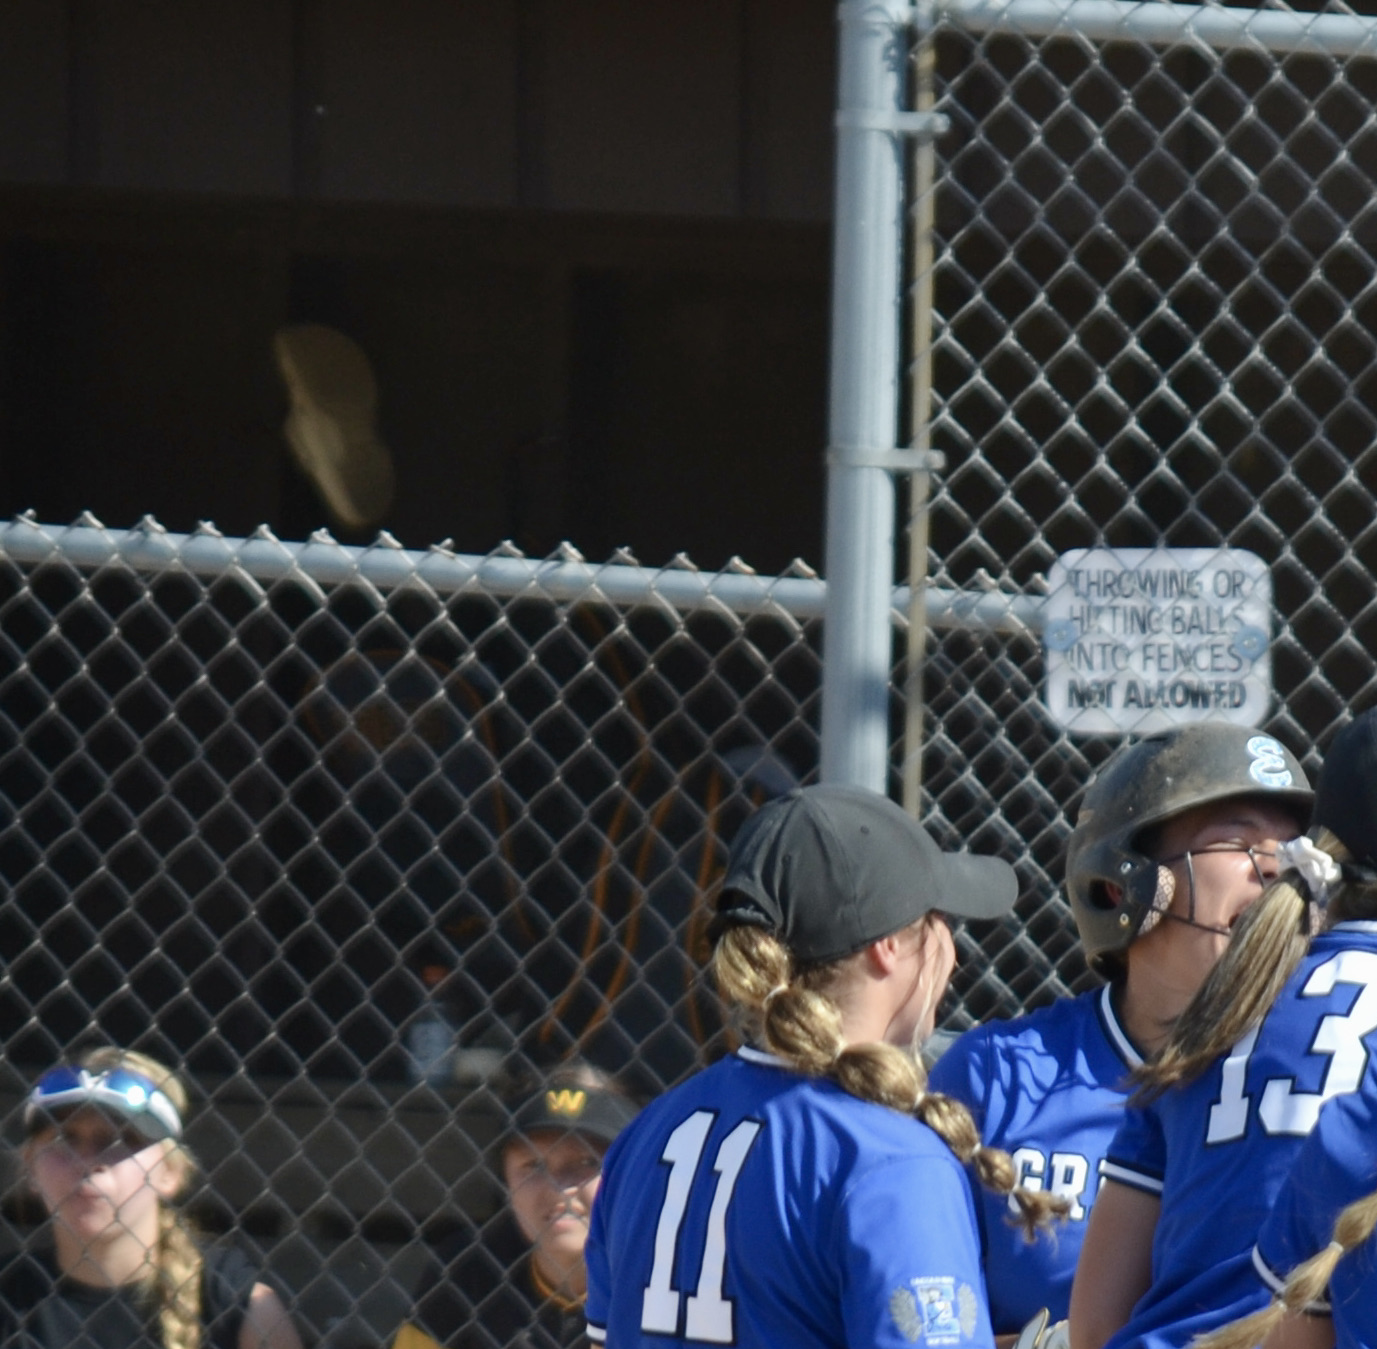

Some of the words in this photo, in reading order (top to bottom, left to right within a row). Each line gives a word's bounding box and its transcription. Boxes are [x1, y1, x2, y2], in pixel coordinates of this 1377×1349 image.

[1069, 569, 1203, 599] THROWING
[1213, 569, 1246, 598] OR
[1069, 604, 1163, 634] HITTING
[1171, 605, 1246, 635] BALLS
[1069, 642, 1129, 672] INTO
[1142, 643, 1244, 672] FENCES
[1067, 678, 1116, 708] NOT
[1122, 679, 1247, 709] ALLOWED
[546, 1089, 587, 1114] W
[640, 1109, 763, 1345] 11
